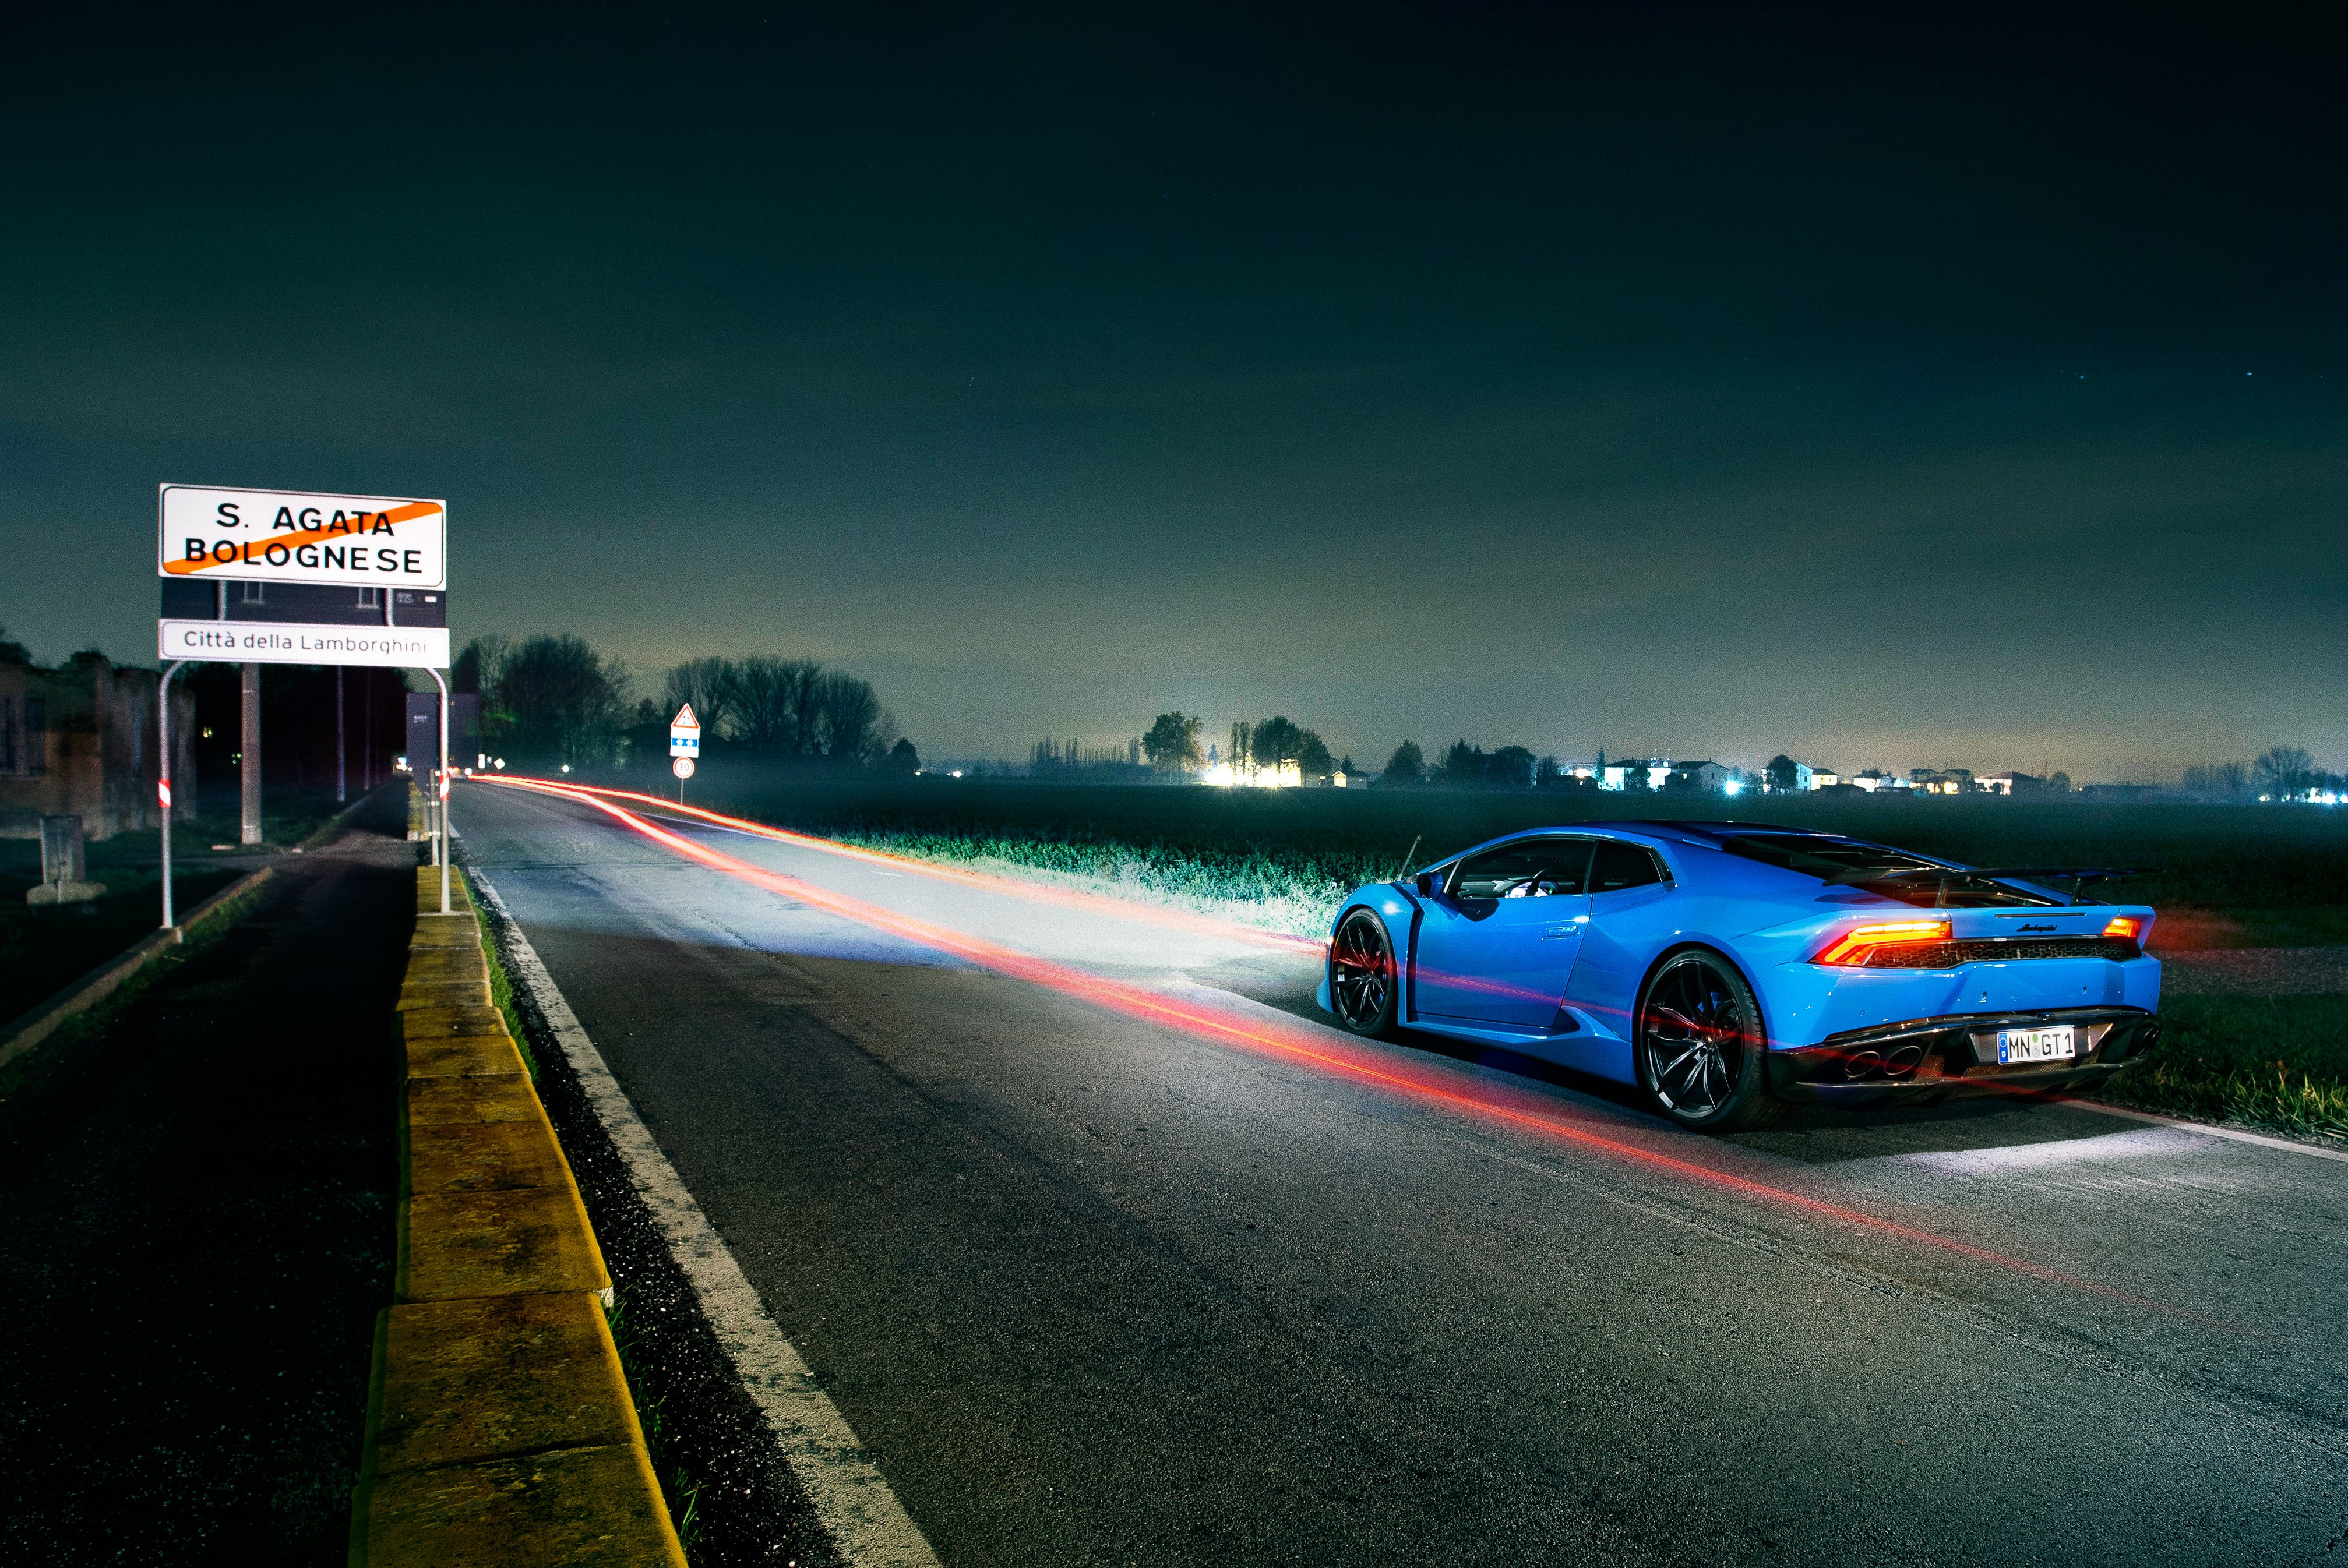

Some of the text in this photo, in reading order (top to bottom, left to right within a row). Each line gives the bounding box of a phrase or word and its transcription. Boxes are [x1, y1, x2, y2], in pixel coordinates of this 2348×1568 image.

[216, 503, 394, 536] S. AGATA
[185, 538, 422, 574] BOLOGNESE
[184, 631, 426, 656] Città della Lamborghini
[679, 763, 689, 771] 70
[2009, 1036, 2030, 1058] MN
